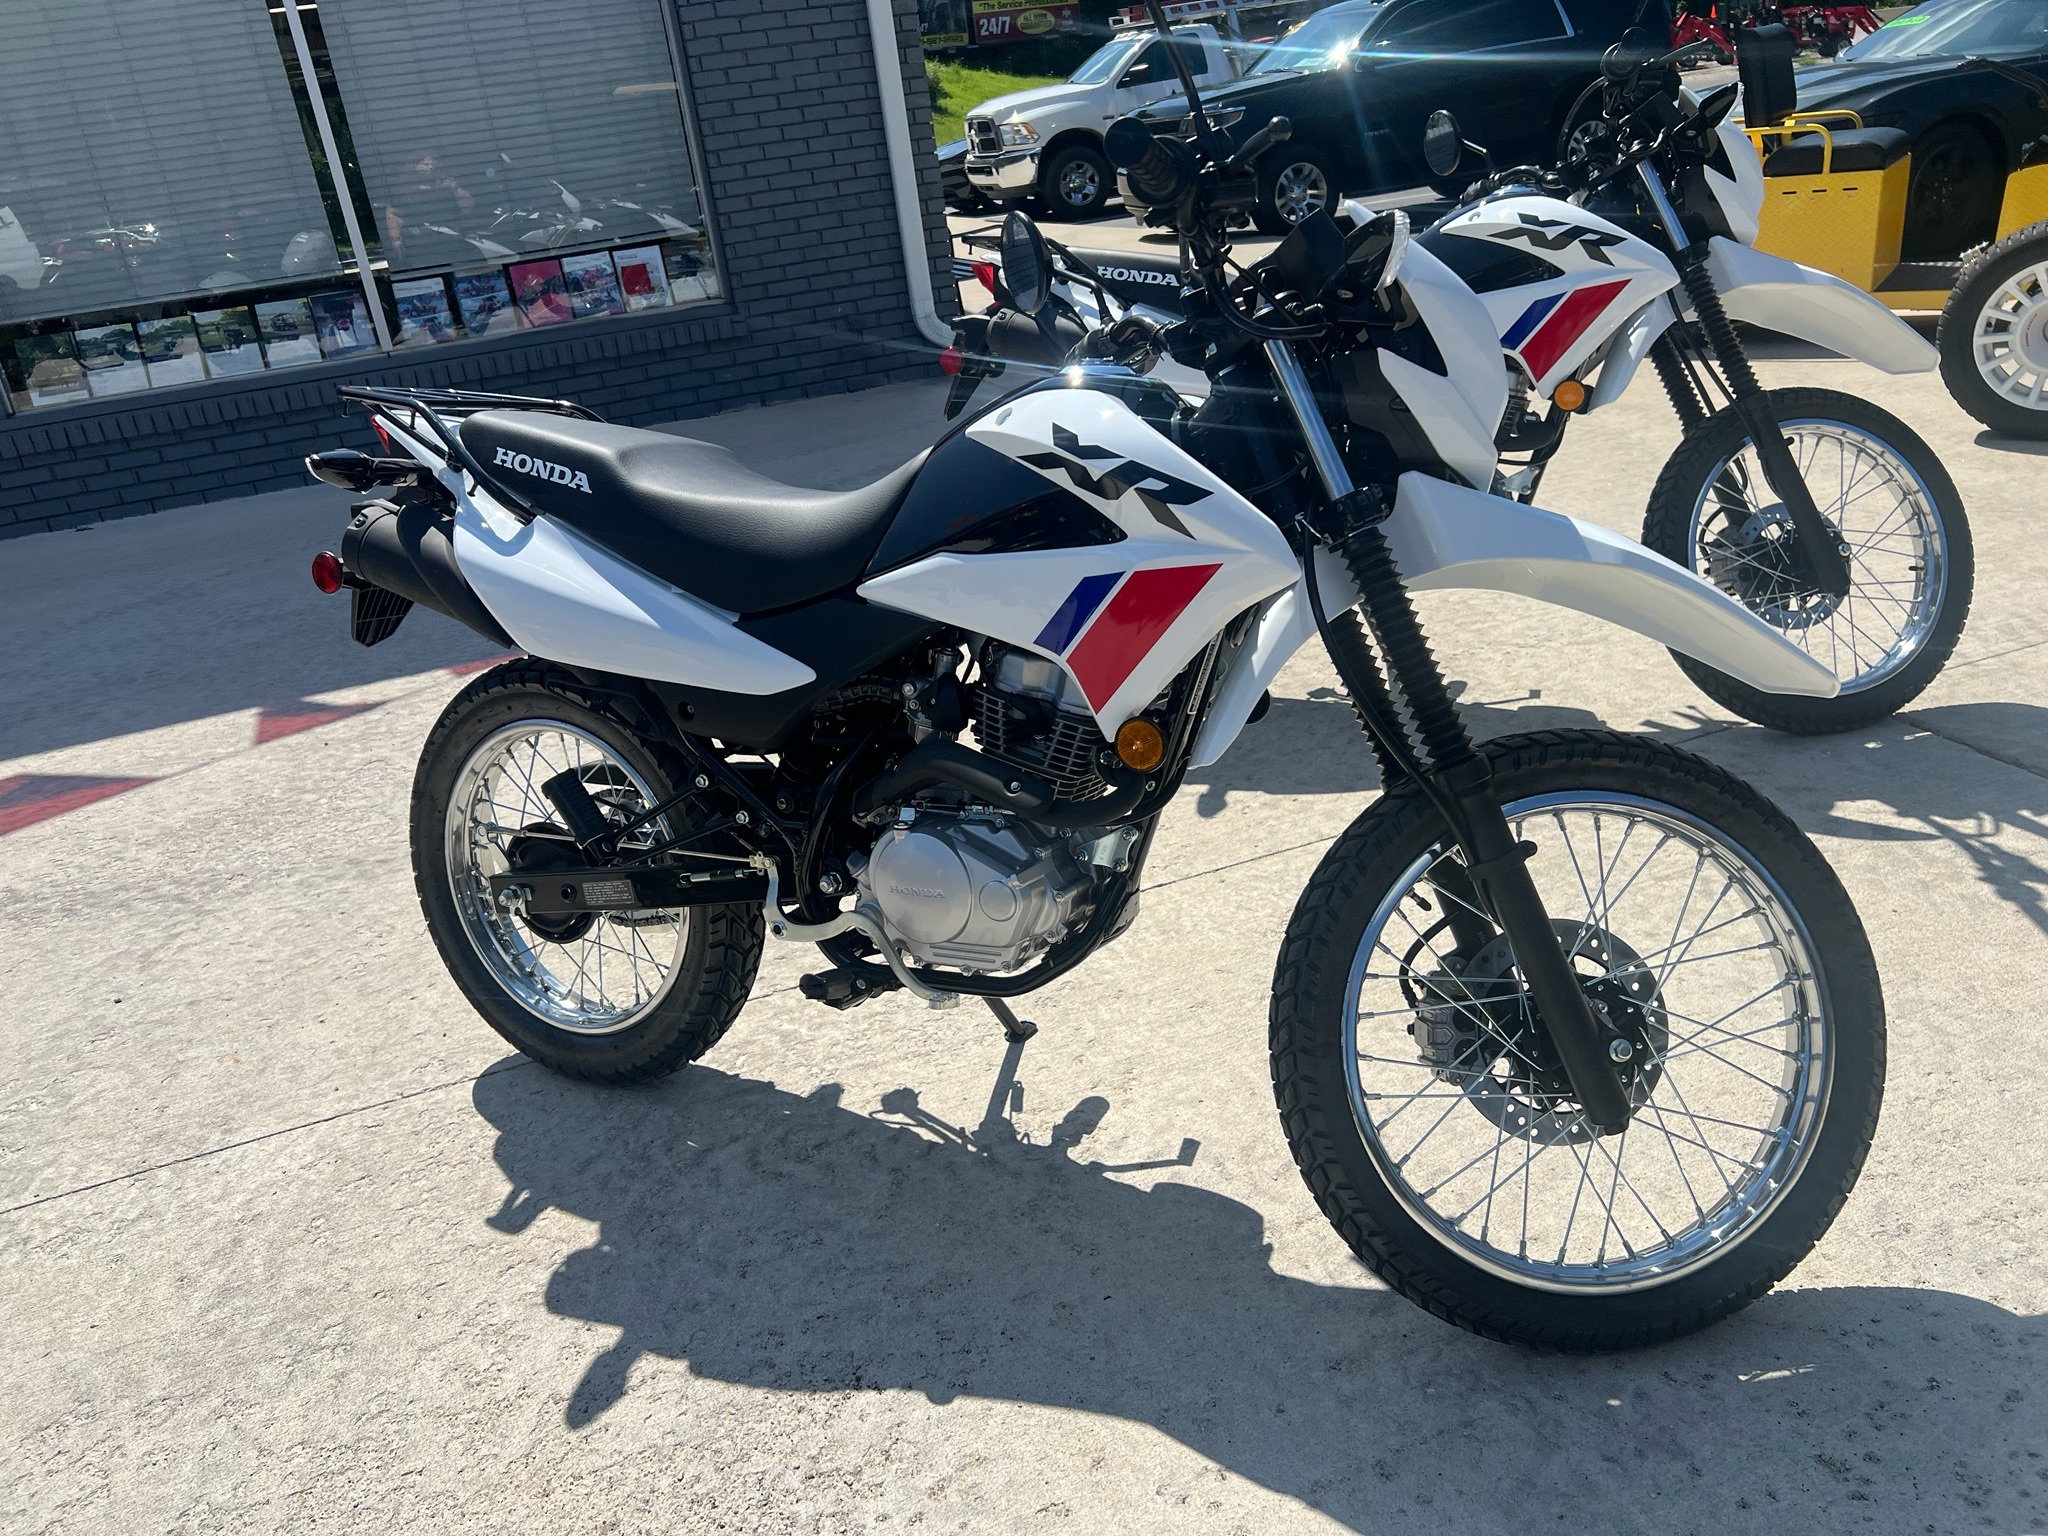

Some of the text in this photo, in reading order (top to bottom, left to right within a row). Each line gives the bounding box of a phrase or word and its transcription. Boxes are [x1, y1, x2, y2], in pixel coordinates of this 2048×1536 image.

[979, 16, 1011, 36] 24/7
[1097, 266, 1180, 287] HONDA
[493, 446, 593, 494] HONDA
[889, 884, 946, 899] HONDA
